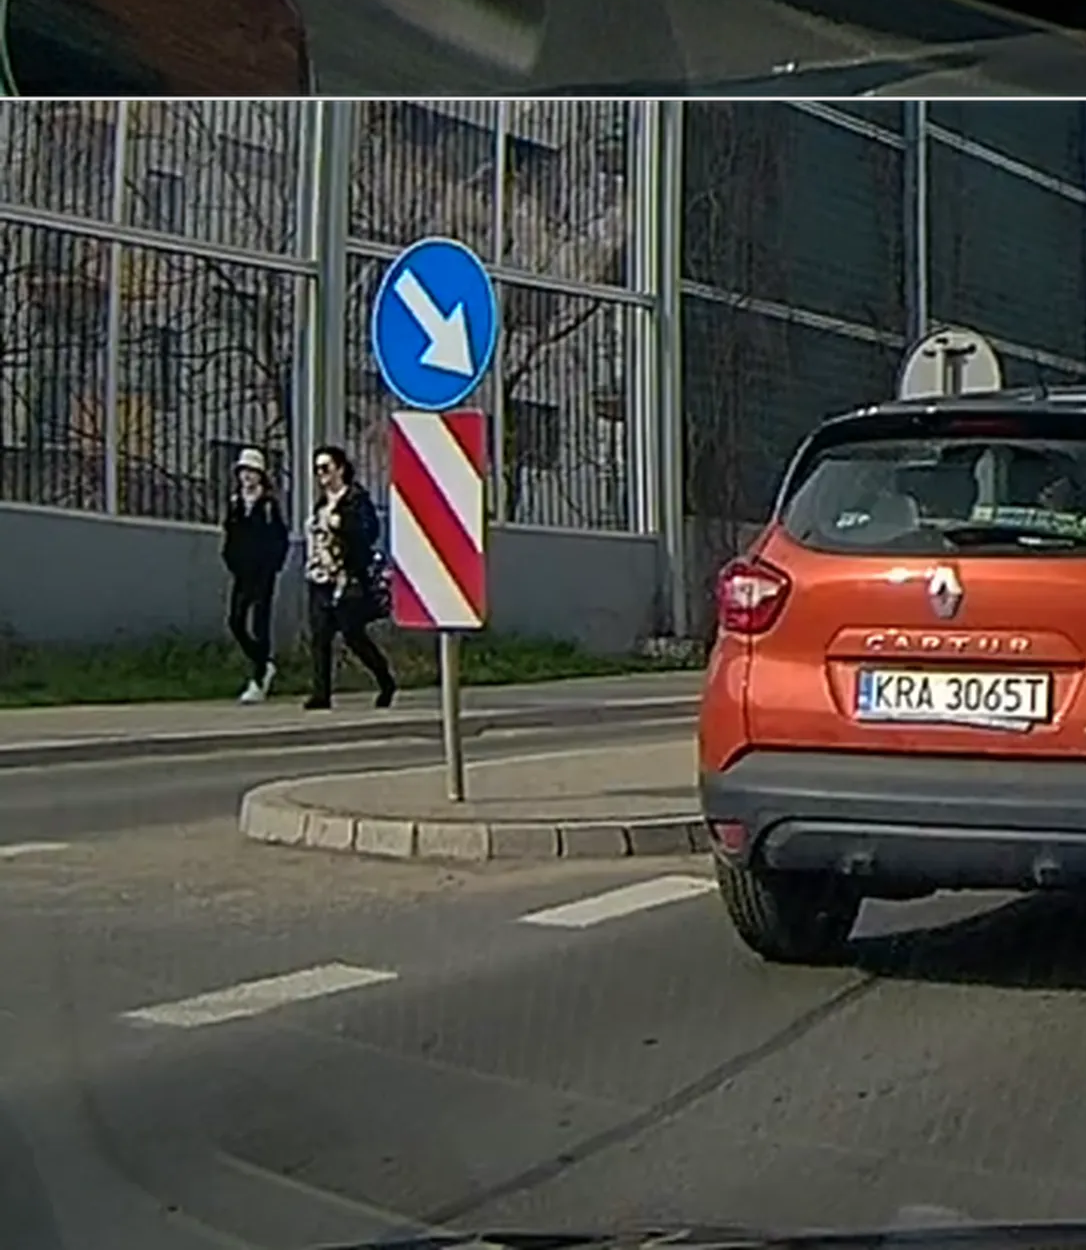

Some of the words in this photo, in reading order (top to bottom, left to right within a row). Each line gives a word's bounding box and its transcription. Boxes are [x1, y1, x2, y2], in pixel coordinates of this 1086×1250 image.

[865, 634, 1032, 652] CAPTUR
[875, 676, 935, 710] KRA
[945, 678, 1045, 713] 3065T
